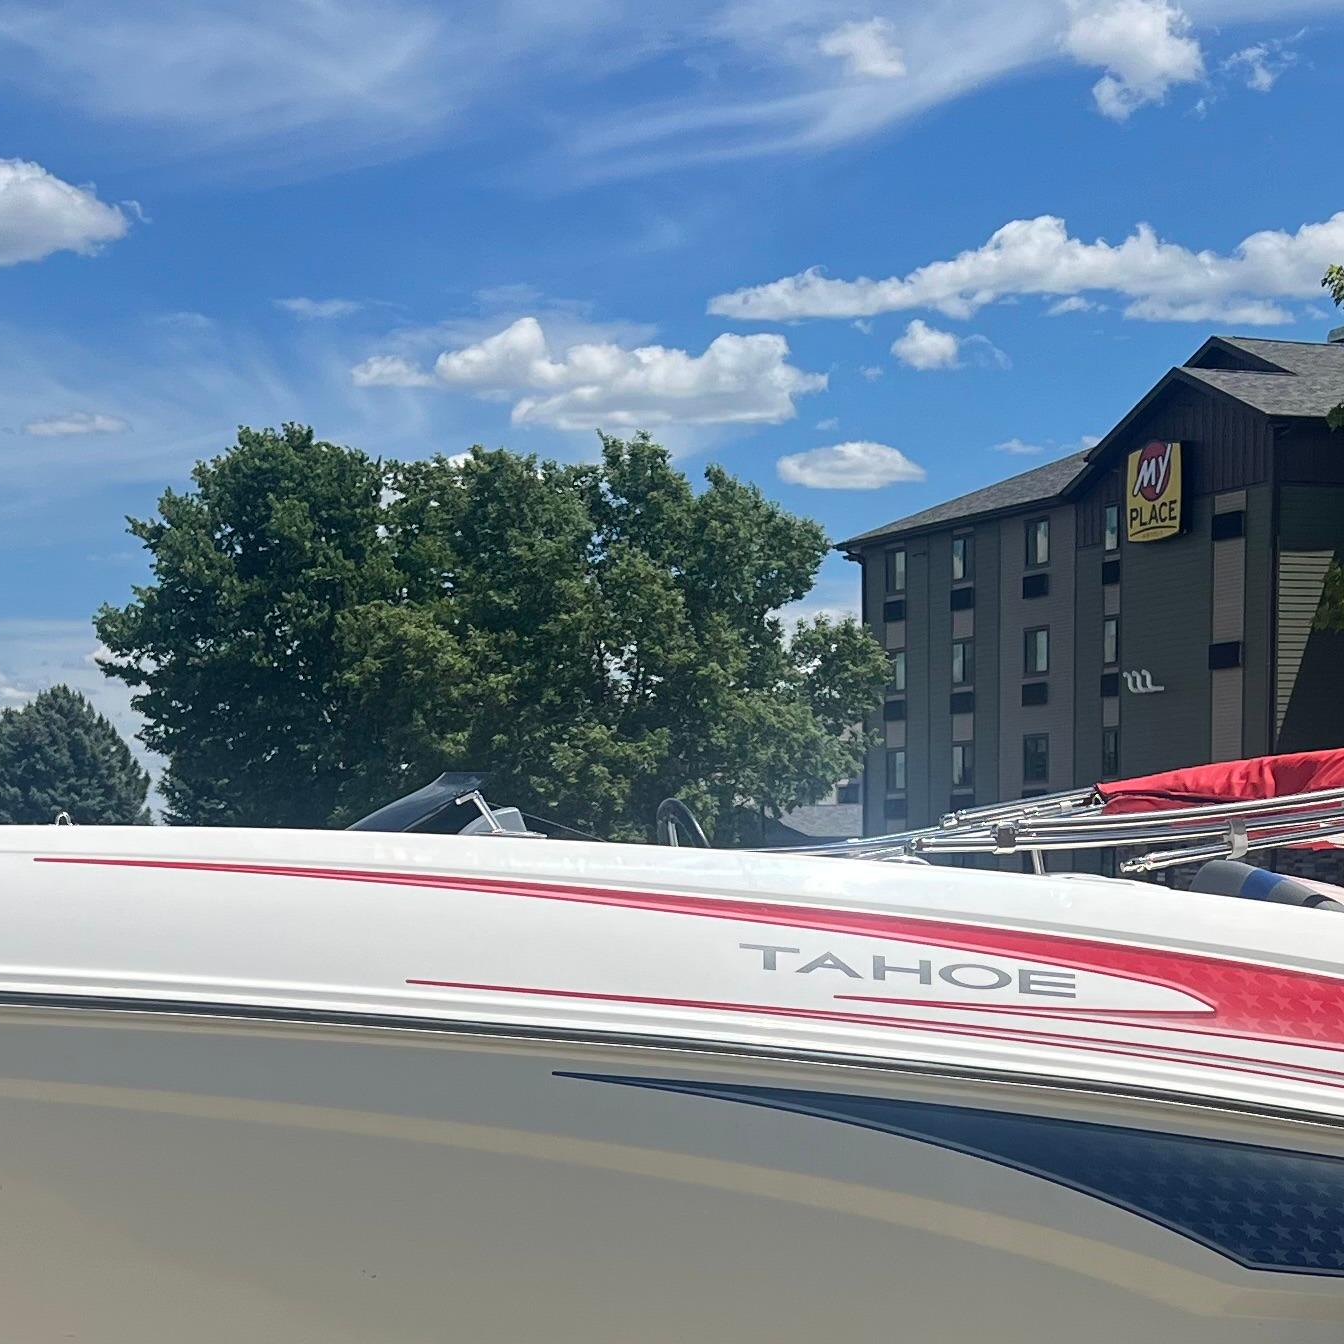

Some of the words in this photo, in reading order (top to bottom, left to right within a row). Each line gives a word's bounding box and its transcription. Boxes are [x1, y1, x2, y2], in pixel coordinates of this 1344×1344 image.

[1133, 443, 1172, 496] MY
[1129, 500, 1177, 529] PLACE
[739, 942, 1076, 999] TAHOE
